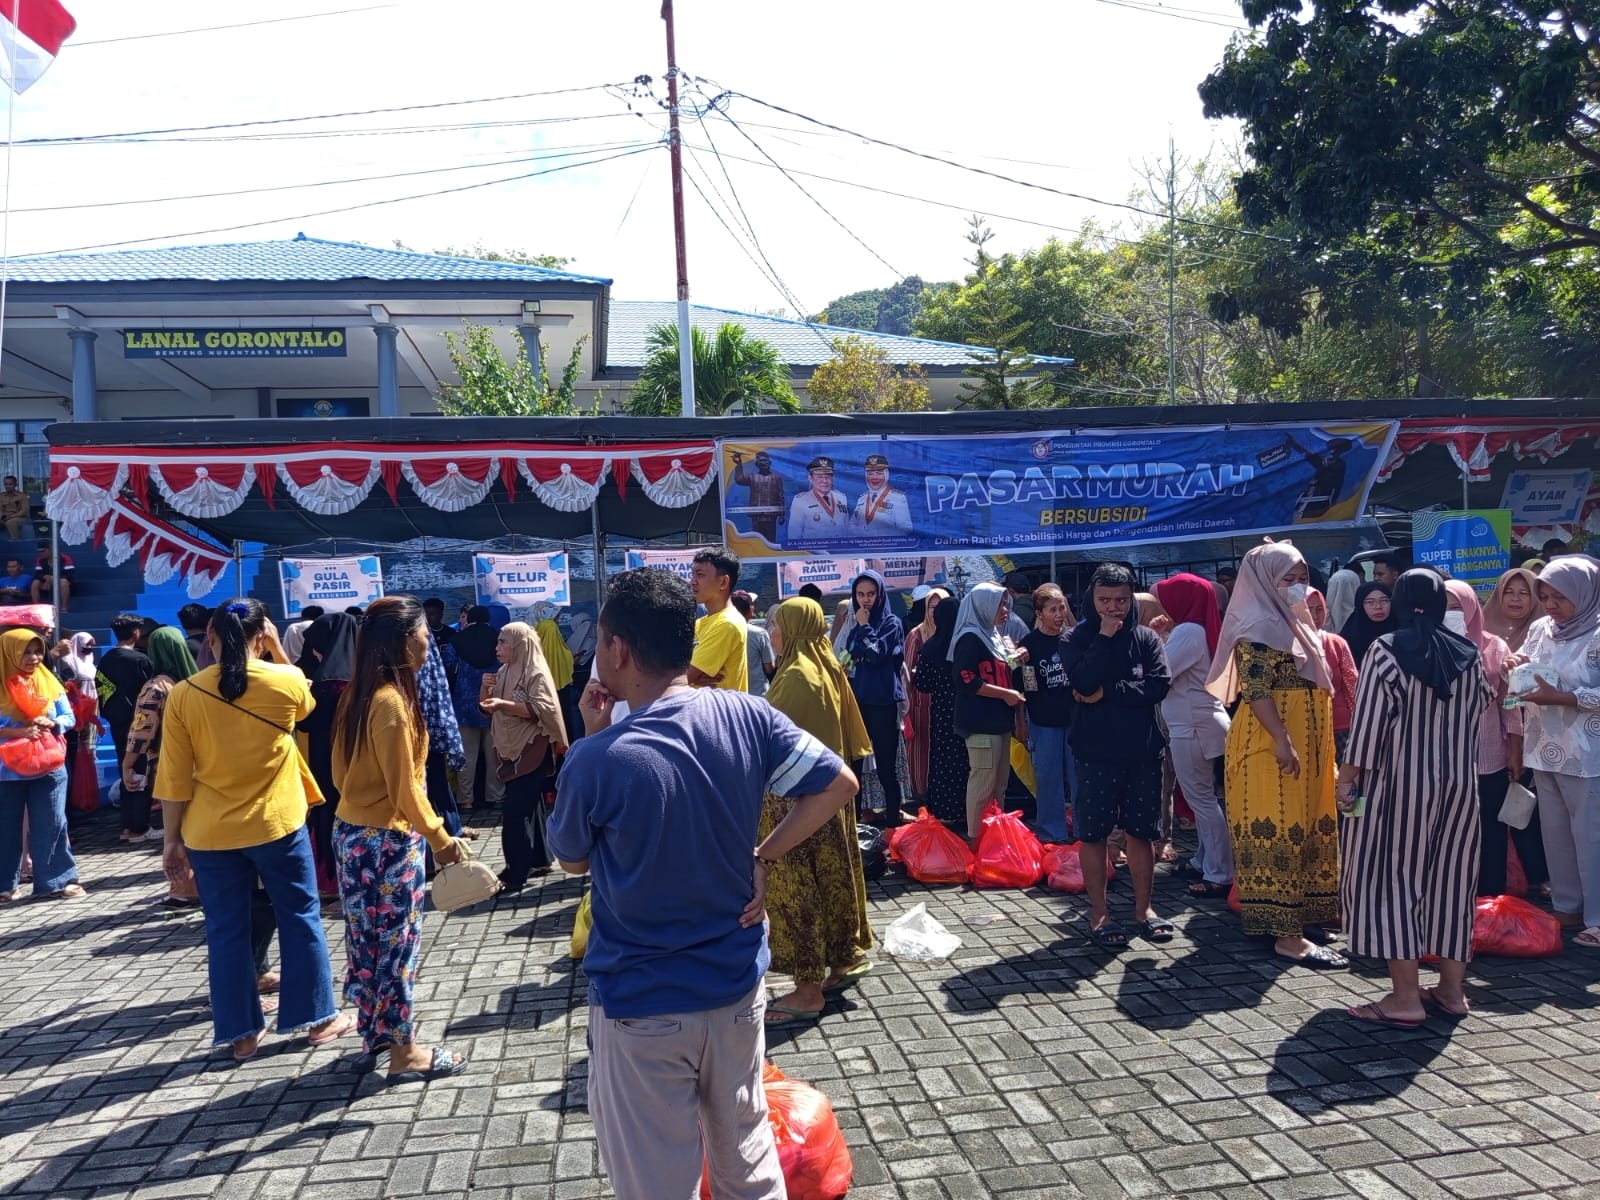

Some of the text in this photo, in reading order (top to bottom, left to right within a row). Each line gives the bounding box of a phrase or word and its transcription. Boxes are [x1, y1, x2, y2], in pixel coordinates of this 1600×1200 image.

[126, 331, 344, 349] LANAL GORONTALO
[925, 462, 1254, 513] PASAR MURAH
[1526, 490, 1567, 501] AYAM
[1040, 506, 1148, 526] BERSUBSIDI
[934, 517, 1235, 545] Dalam Rangka Stabilisasi Harga dan Pengendalian Inflasi Daerah
[1420, 550, 1452, 562] SUPER
[802, 564, 837, 574] RAWIT
[885, 560, 923, 569] MERAH
[314, 572, 349, 581] GULA
[496, 572, 547, 583] TELUR
[313, 581, 351, 591] PASIR
